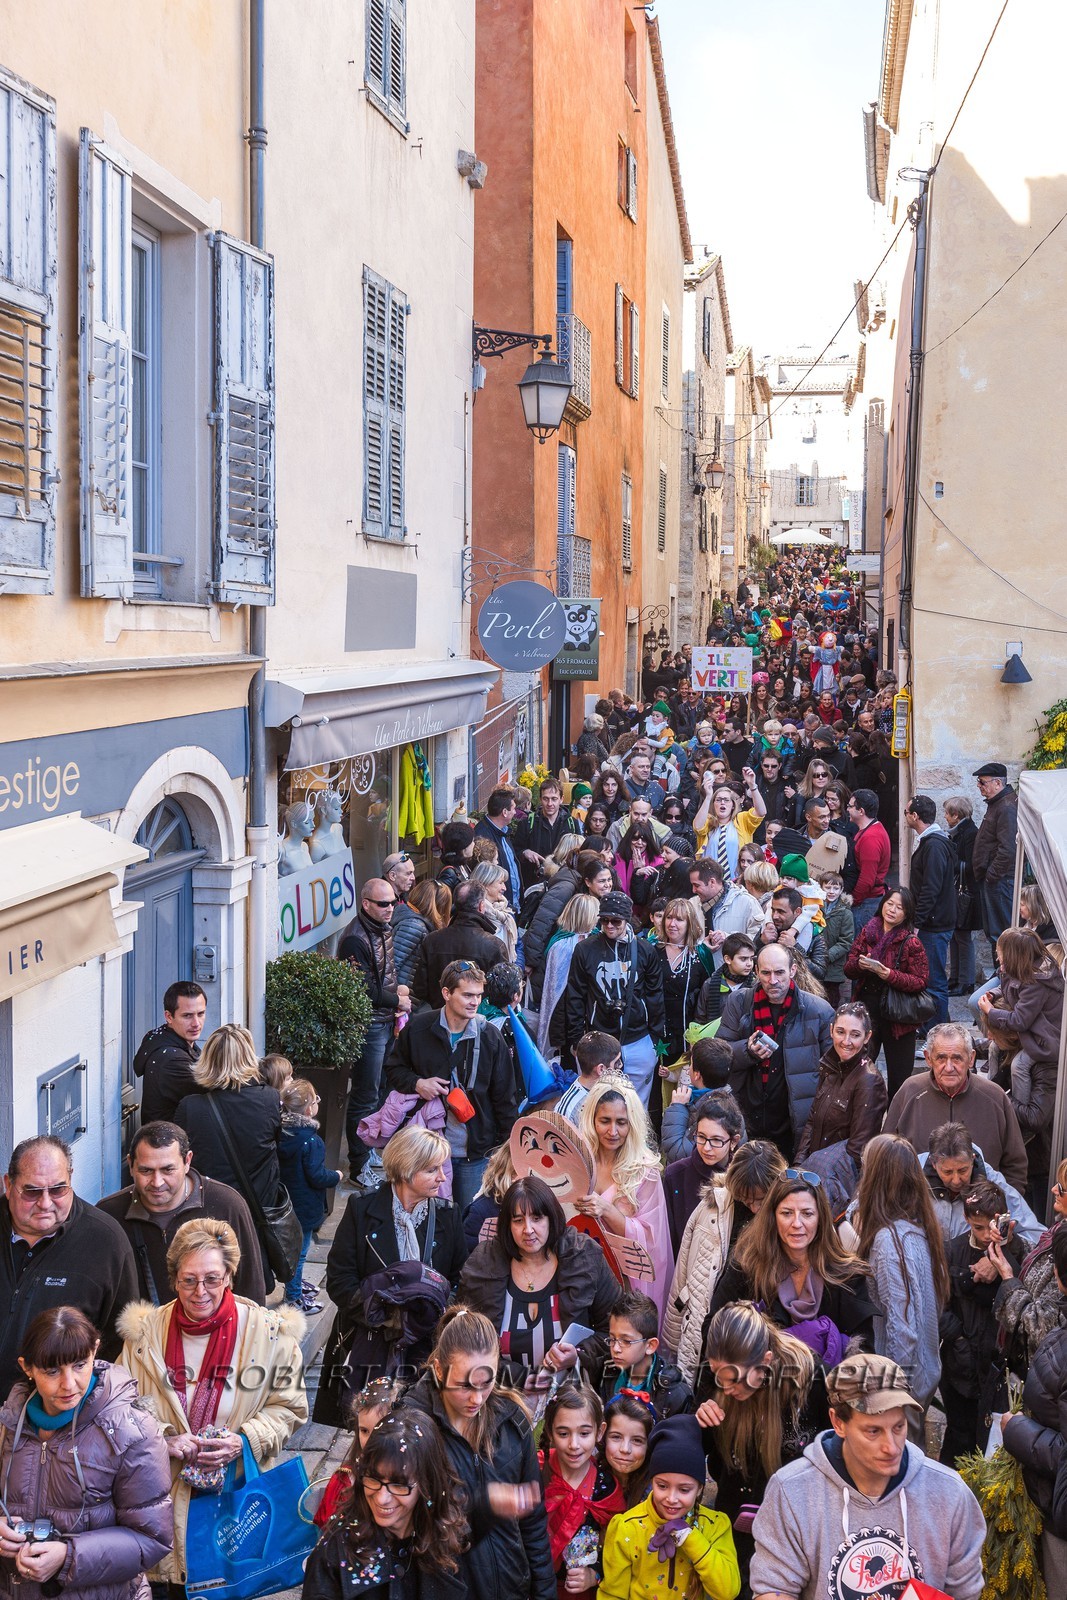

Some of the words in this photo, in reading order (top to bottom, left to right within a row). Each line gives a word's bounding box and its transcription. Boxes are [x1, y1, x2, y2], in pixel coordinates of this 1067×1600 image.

[488, 596, 504, 604] Une
[482, 601, 557, 640] Perle
[522, 647, 551, 658] Valbonne
[555, 657, 566, 665] 365
[566, 657, 598, 665] FROMAGES
[707, 653, 732, 667] ILE
[695, 669, 748, 689] VERTE
[374, 723, 390, 747] Une
[392, 709, 410, 742] Perle
[0, 756, 81, 812] estige
[277, 861, 355, 943] oLDeS
[8, 939, 44, 976] IER
[216, 1536, 227, 1547] les
[239, 1510, 268, 1545] emballent
[849, 1555, 904, 1588] Fresh
